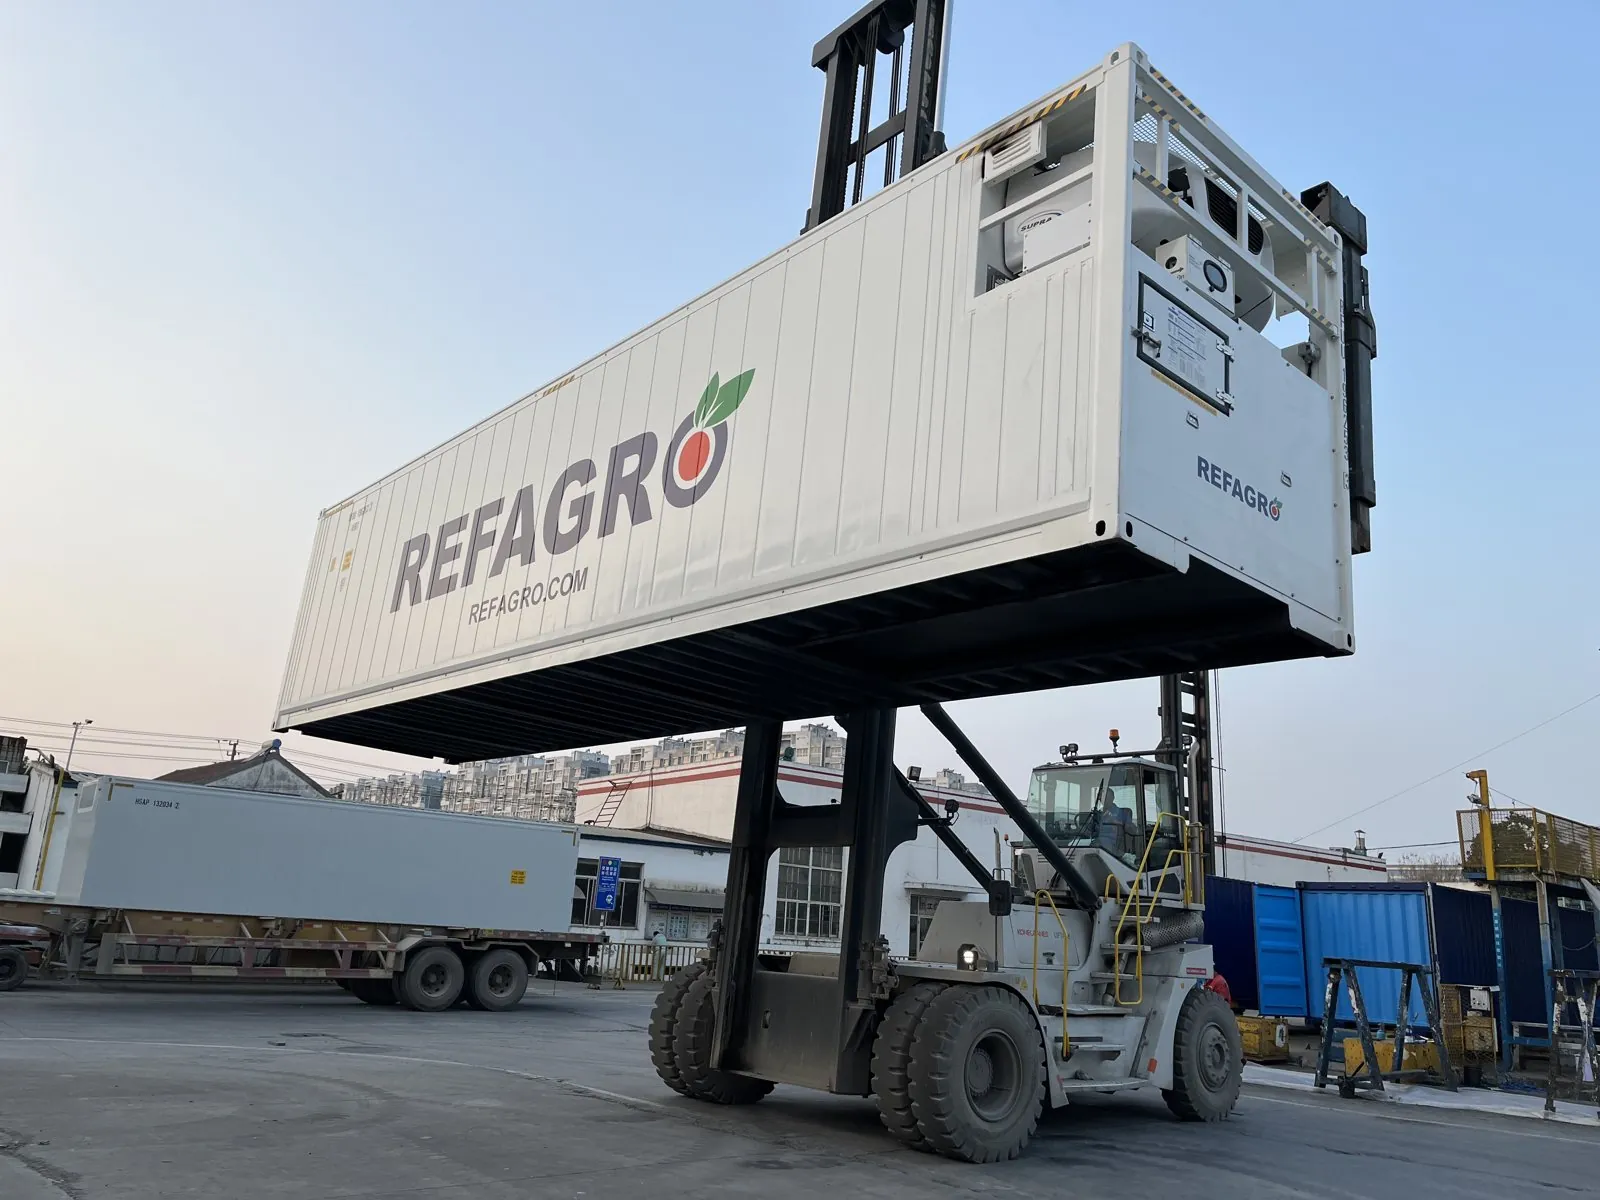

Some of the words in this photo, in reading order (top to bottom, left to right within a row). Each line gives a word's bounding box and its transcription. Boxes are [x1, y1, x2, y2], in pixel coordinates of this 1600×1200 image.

[1021, 217, 1053, 232] SUPRA
[390, 410, 728, 613] REFAGRO
[1197, 455, 1280, 522] REFAGRO
[468, 566, 589, 626] REFAGRO.COM
